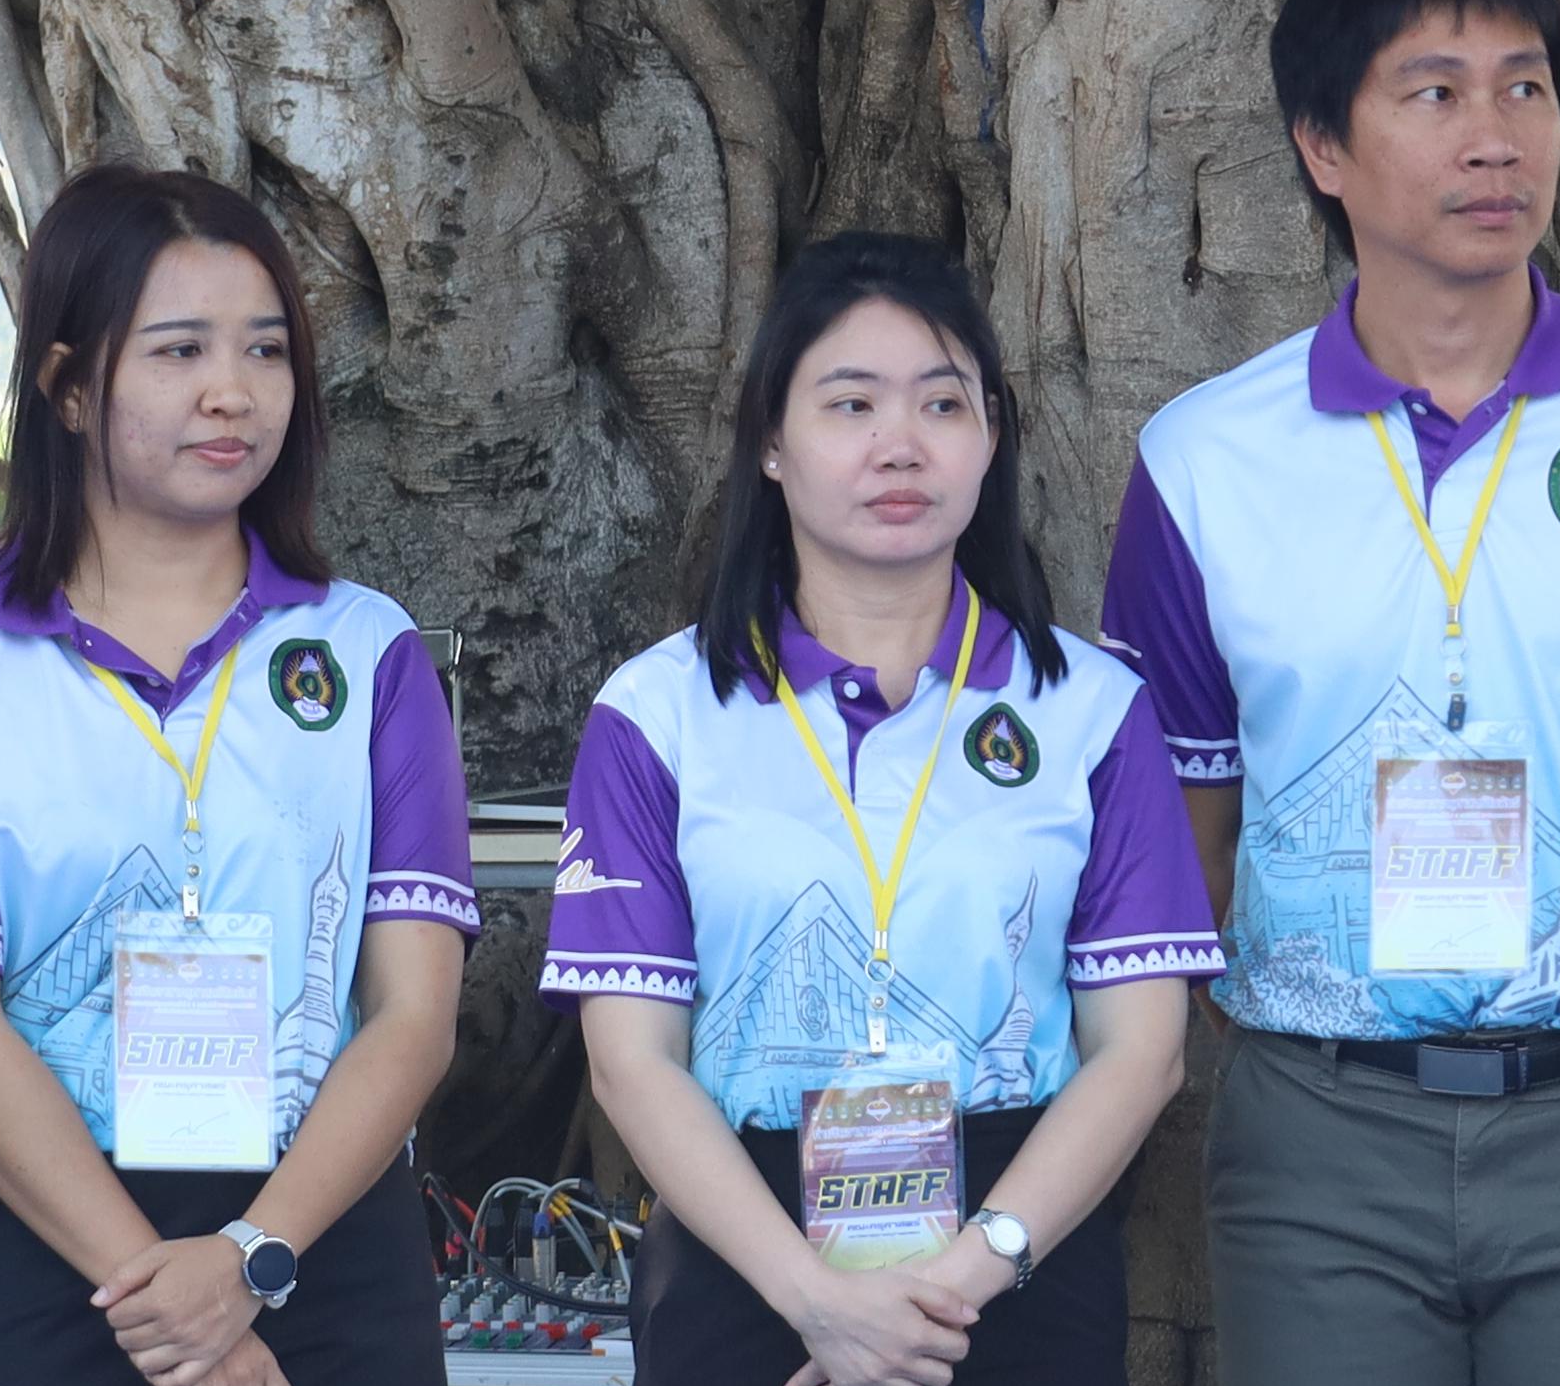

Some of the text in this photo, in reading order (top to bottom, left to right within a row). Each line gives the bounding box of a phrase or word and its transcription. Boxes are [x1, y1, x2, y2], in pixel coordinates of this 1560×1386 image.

[1386, 845, 1521, 879] STAFF
[124, 1032, 258, 1068] STAFF
[818, 1168, 950, 1211] STAFF
